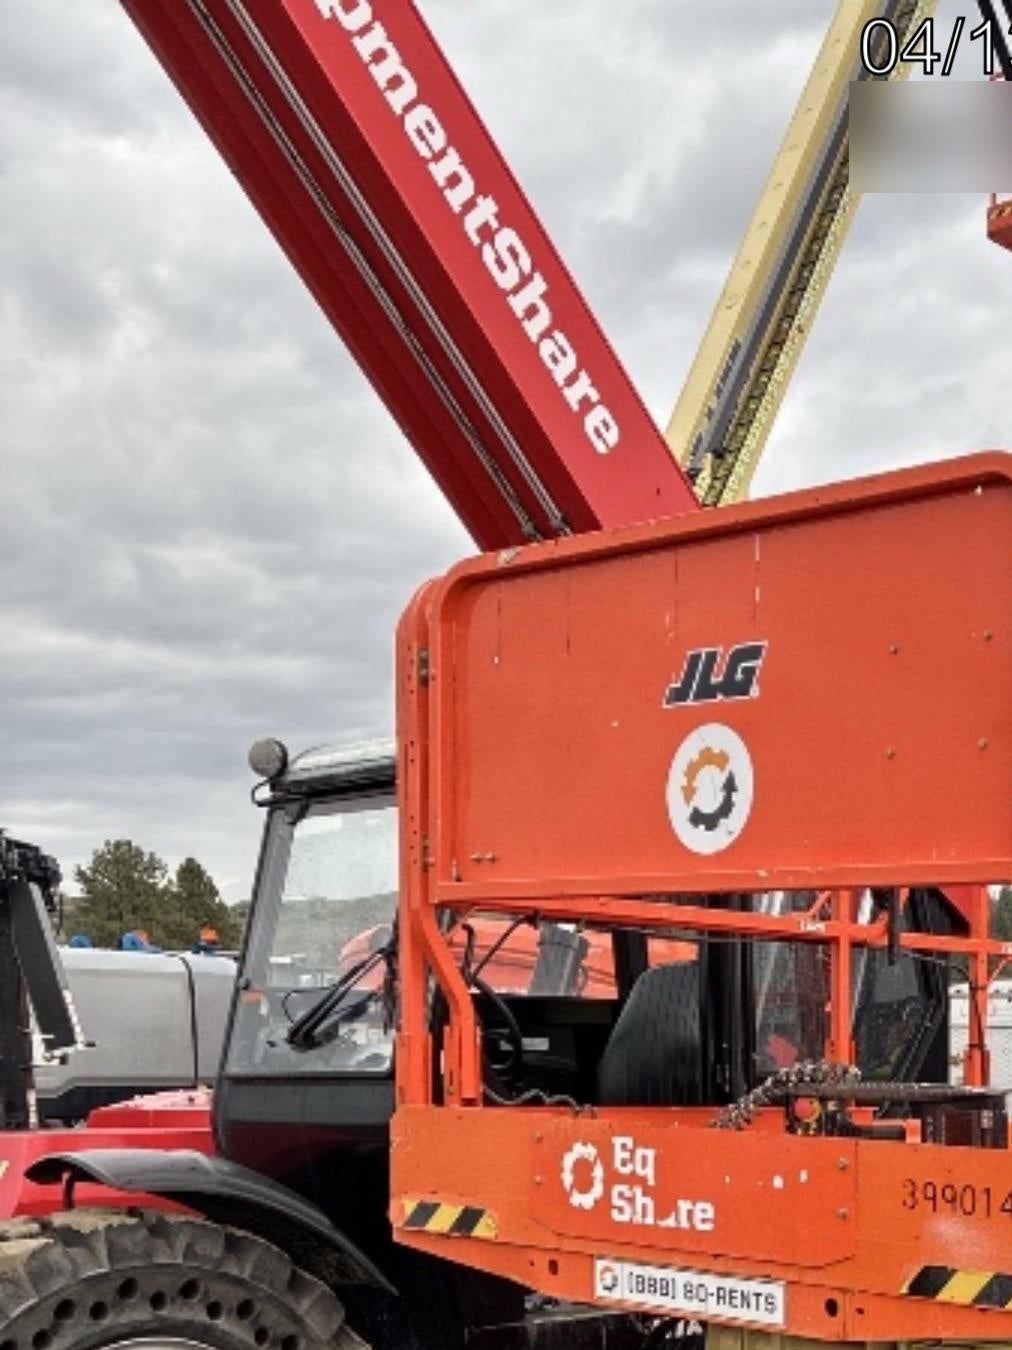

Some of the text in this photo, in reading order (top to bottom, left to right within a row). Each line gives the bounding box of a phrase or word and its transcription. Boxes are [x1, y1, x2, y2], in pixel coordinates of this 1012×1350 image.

[663, 641, 767, 708] JLG
[611, 1135, 656, 1186] Eq
[683, 1281, 777, 1314] 80-RENTS
